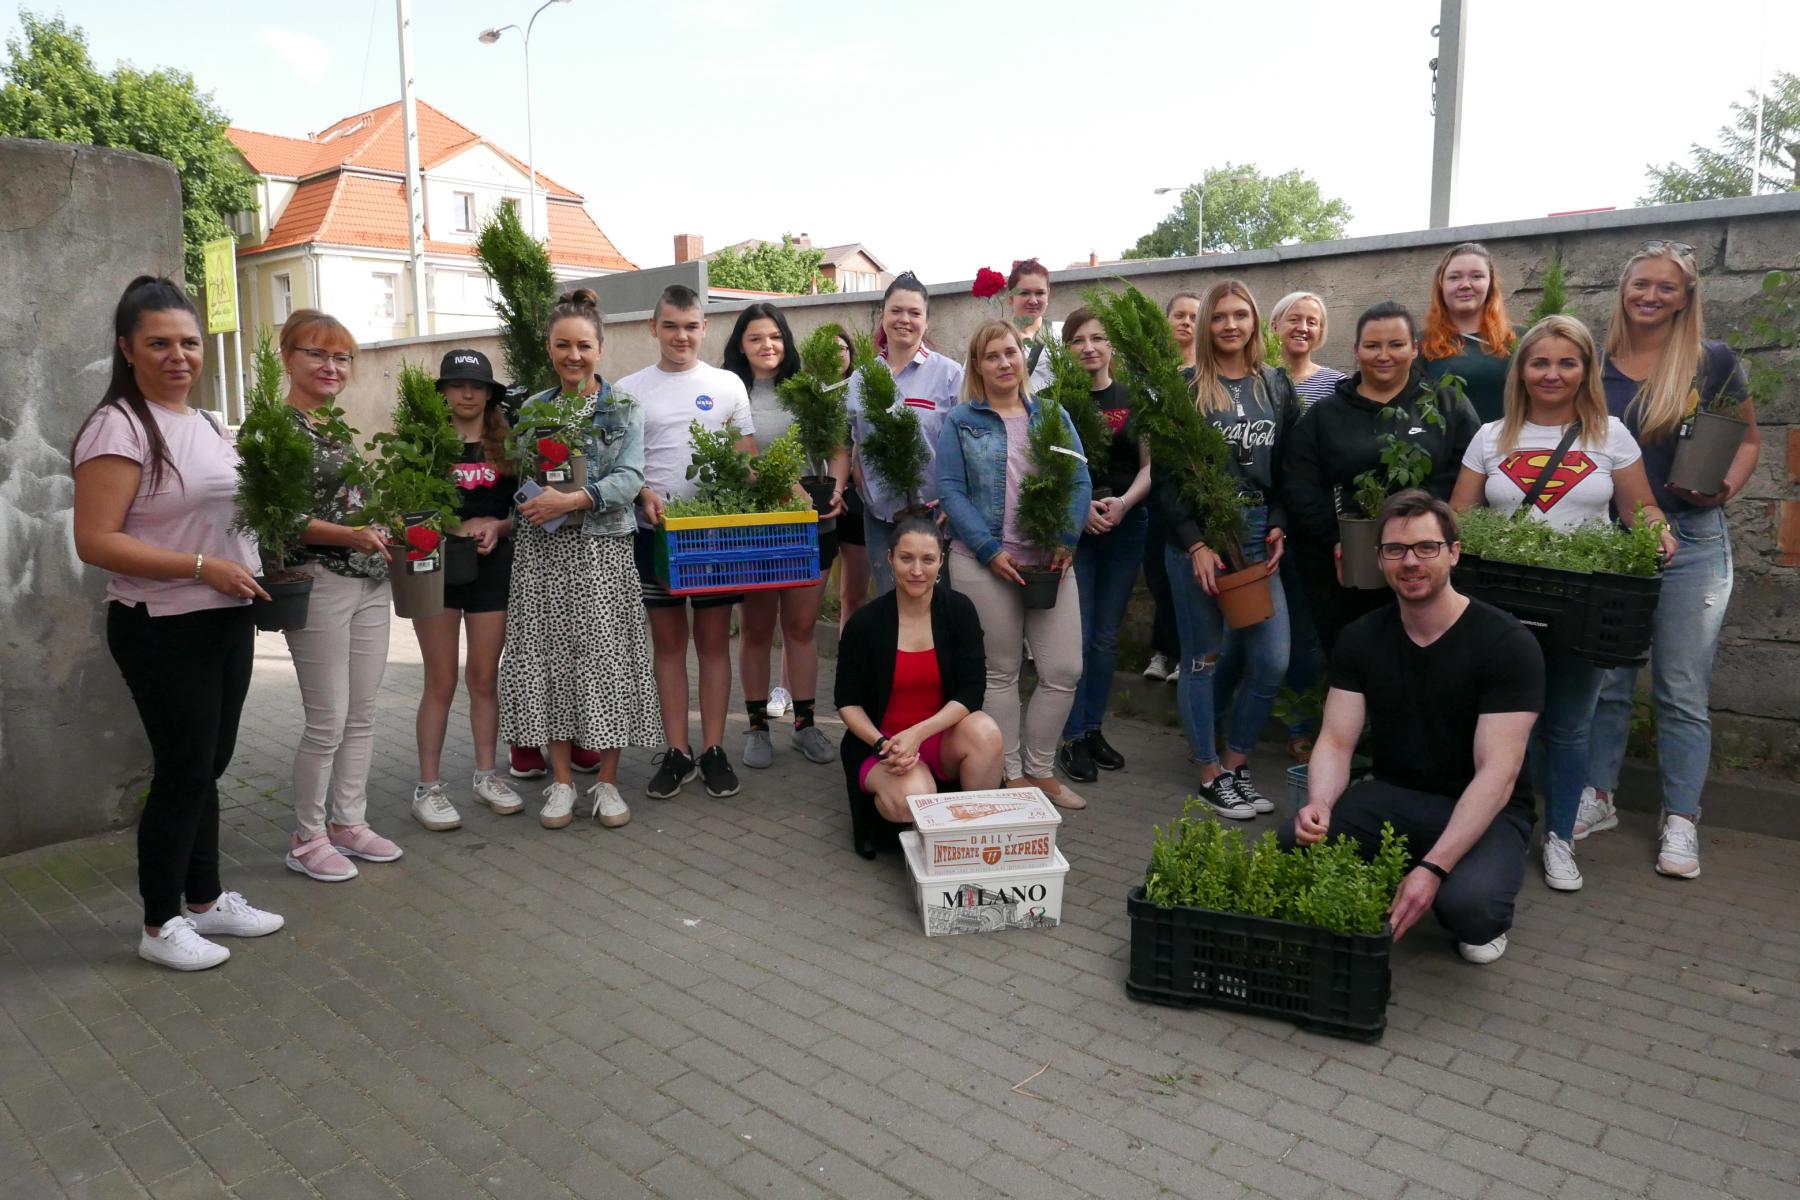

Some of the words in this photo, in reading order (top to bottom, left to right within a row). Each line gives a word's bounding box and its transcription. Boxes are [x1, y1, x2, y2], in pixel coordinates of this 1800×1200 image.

[455, 355, 479, 365] NASA
[970, 833, 1013, 845] DAILY
[934, 844, 979, 864] INTERSTATE
[1004, 836, 1049, 856] EXPRESS
